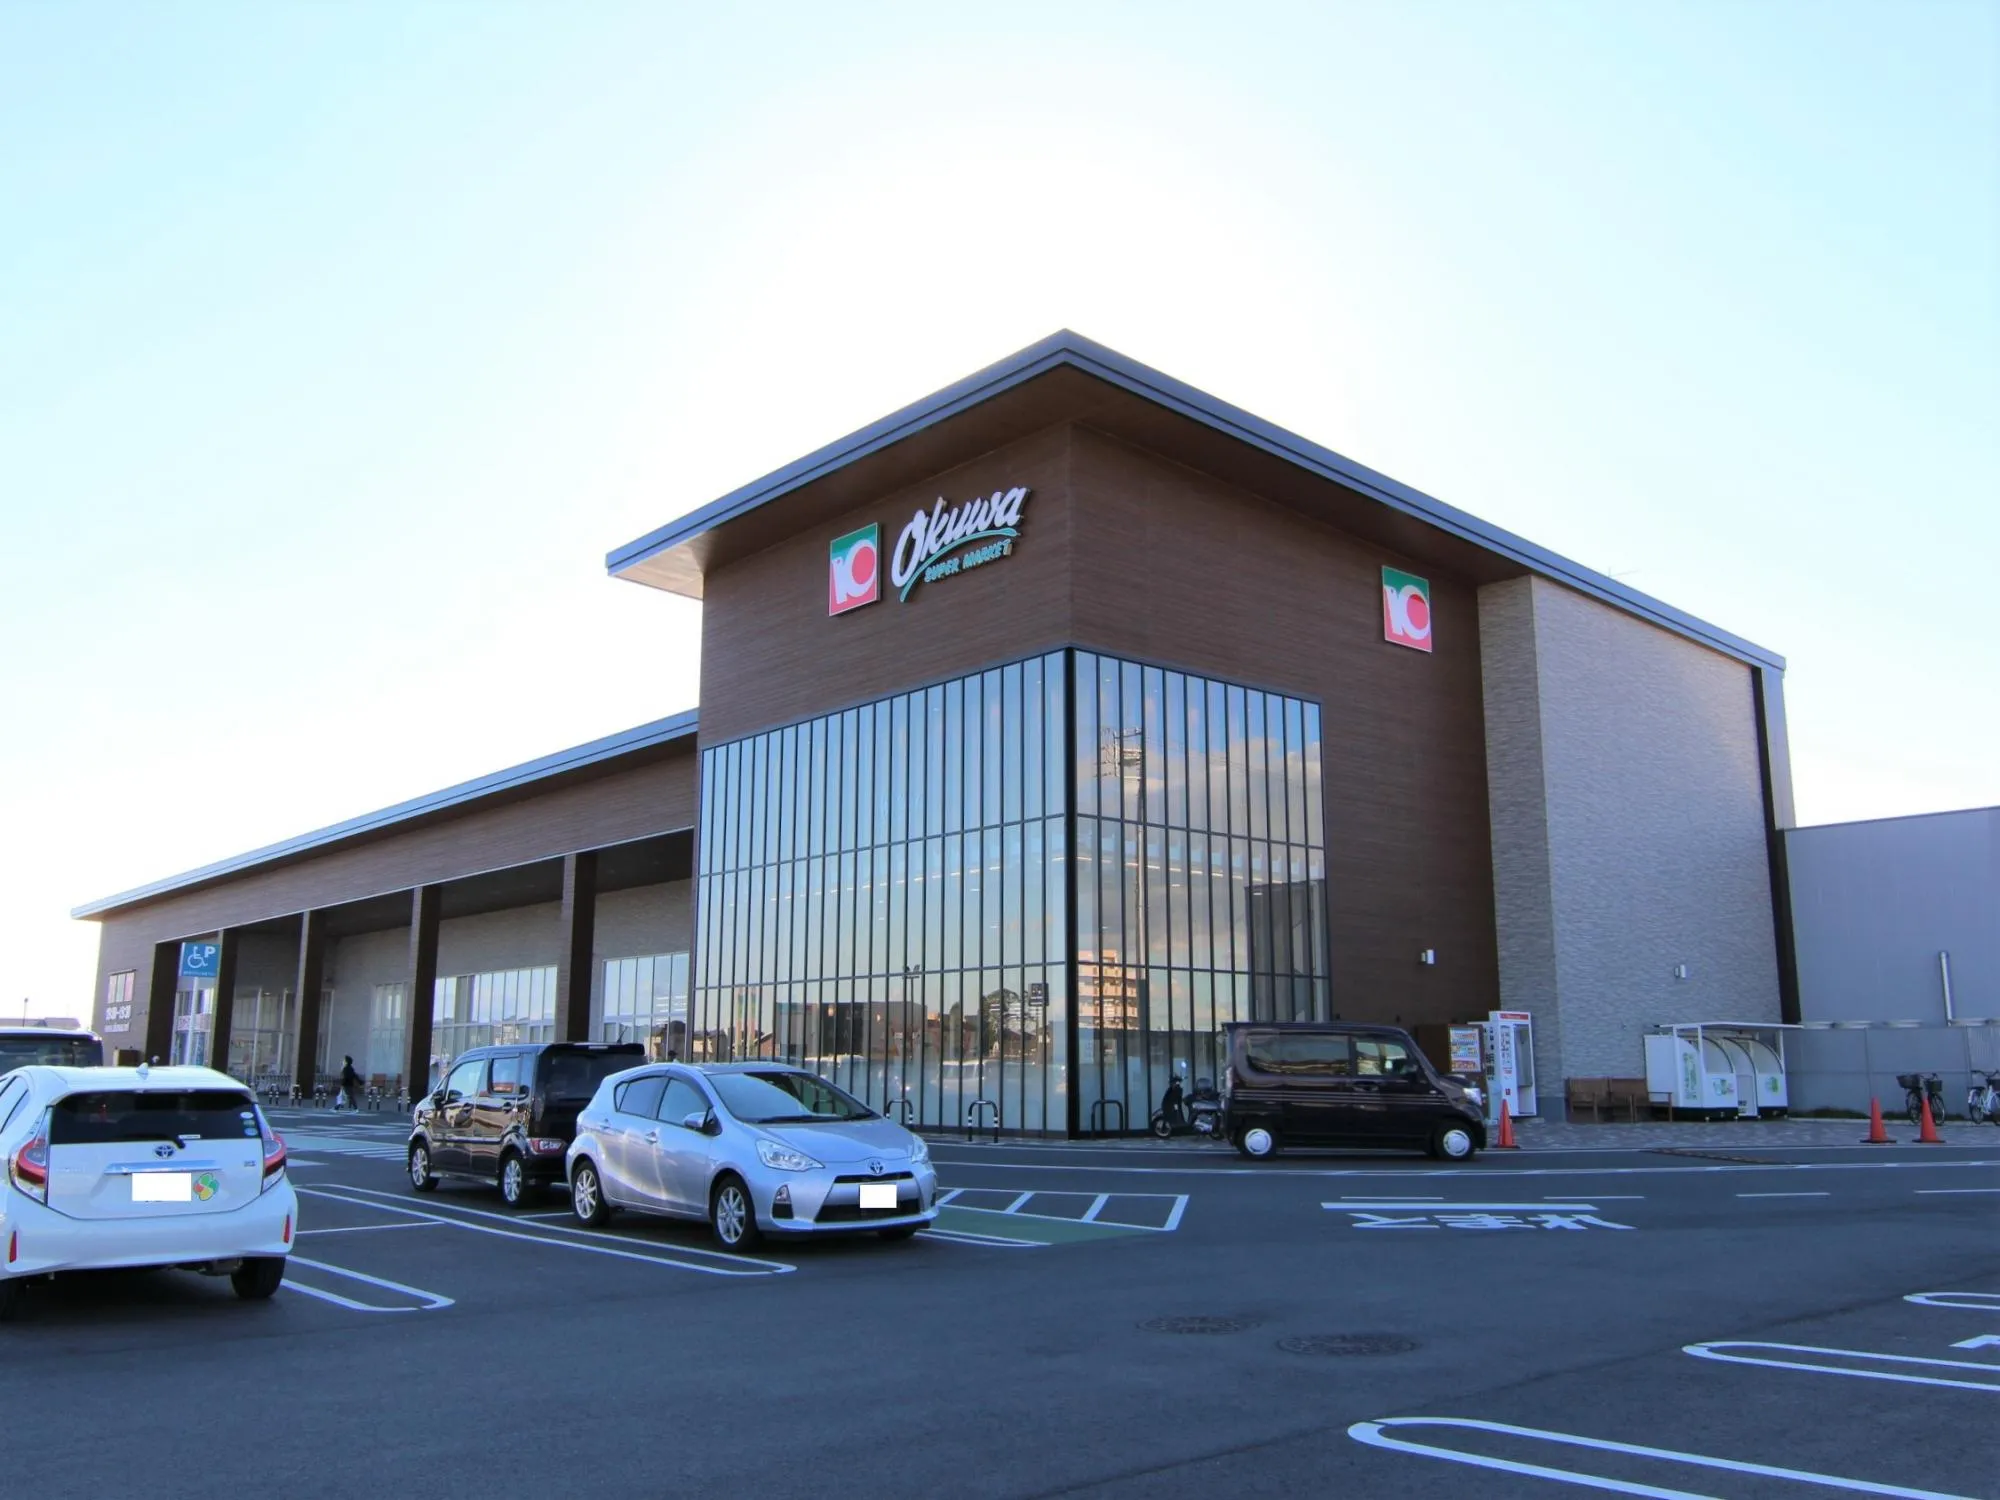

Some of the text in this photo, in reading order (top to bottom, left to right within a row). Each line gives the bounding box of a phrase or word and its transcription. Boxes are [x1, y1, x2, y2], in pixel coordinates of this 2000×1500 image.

[891, 487, 1027, 587] Okuwa
[924, 538, 1012, 583] SUPER MARKET
[204, 946, 216, 958] P
[1347, 1213, 1638, 1230] とまれ
